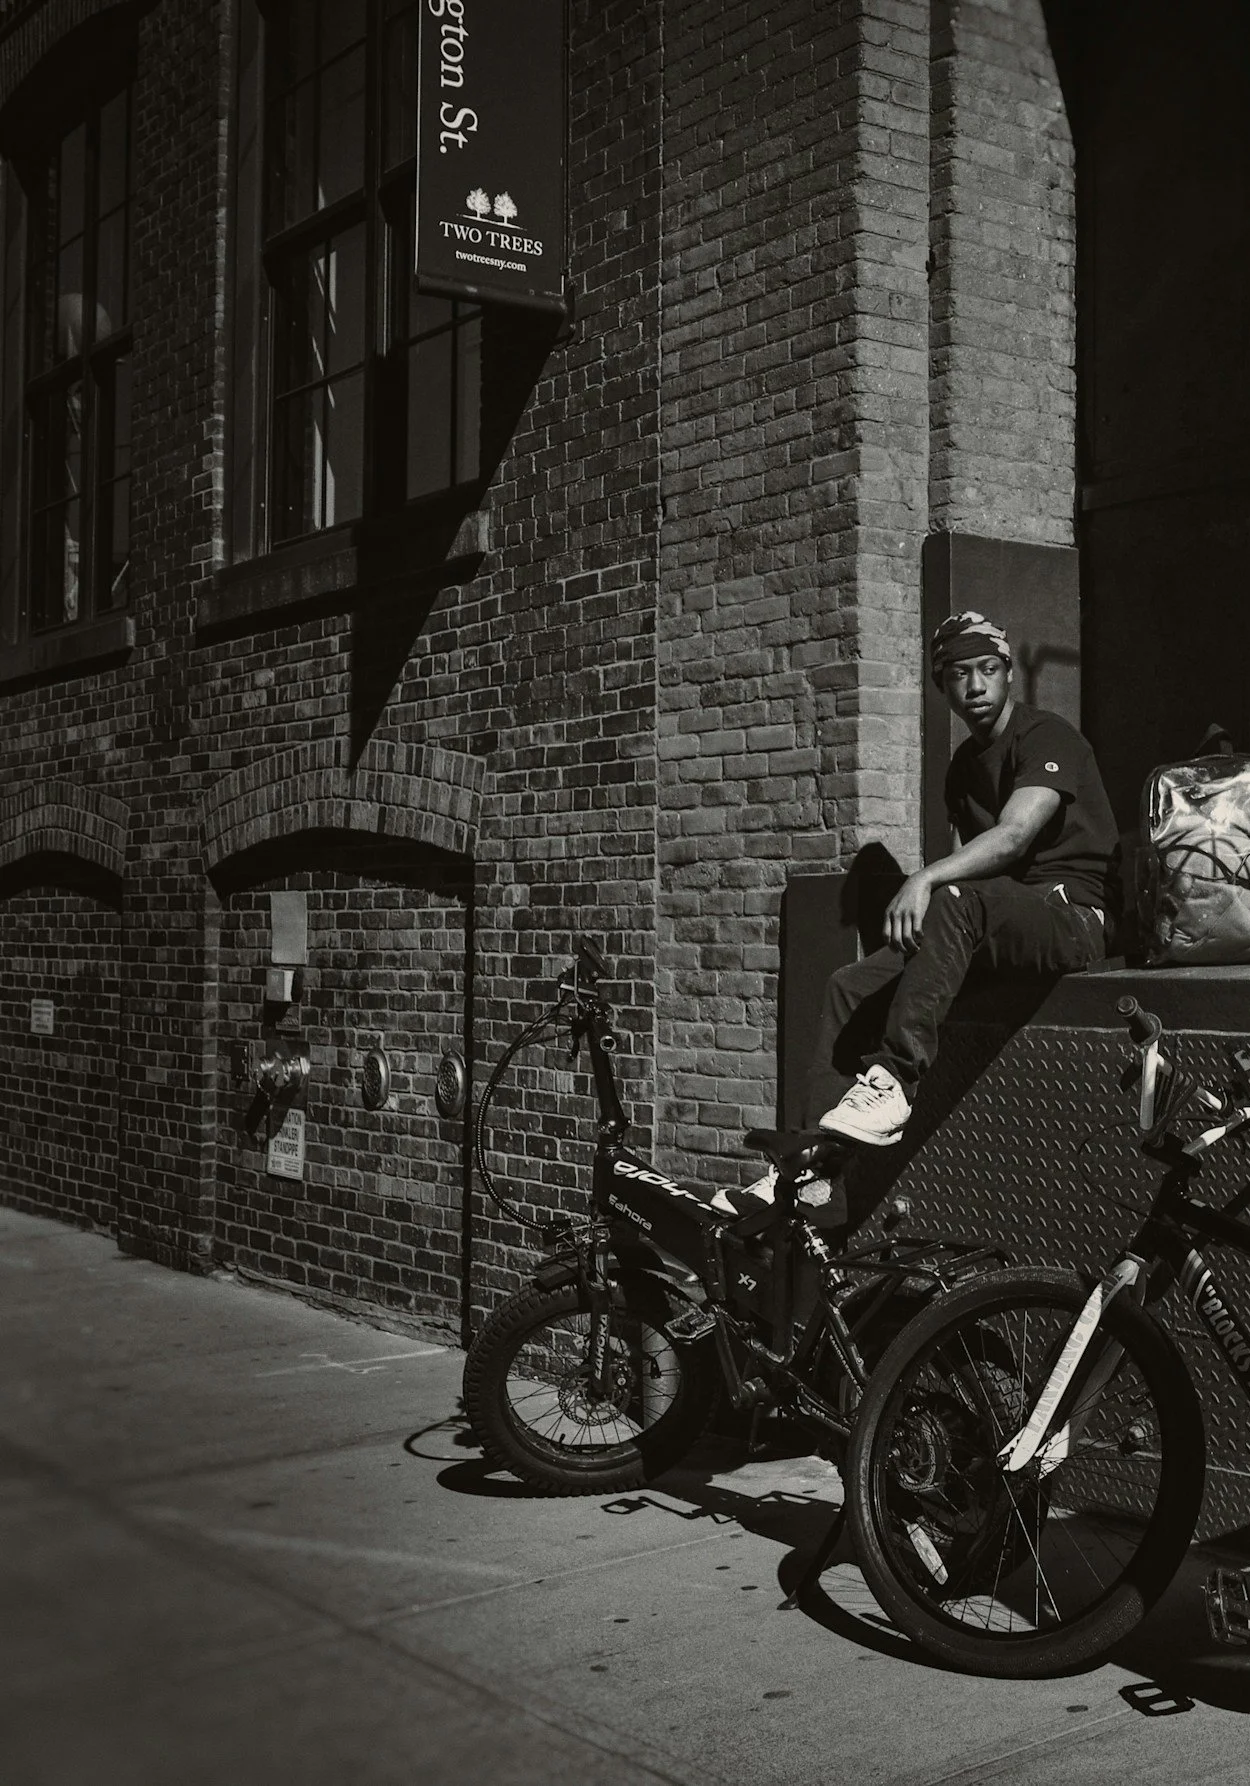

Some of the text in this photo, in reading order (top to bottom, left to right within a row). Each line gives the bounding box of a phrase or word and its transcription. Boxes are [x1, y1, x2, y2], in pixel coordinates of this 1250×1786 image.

[439, 101, 479, 154] St.
[438, 220, 543, 256] TWO TREES
[455, 249, 528, 273] twotreesny.com
[608, 1193, 653, 1232] Eahora
[737, 1272, 757, 1292] X7
[1025, 1330, 1086, 1435] LANDING
